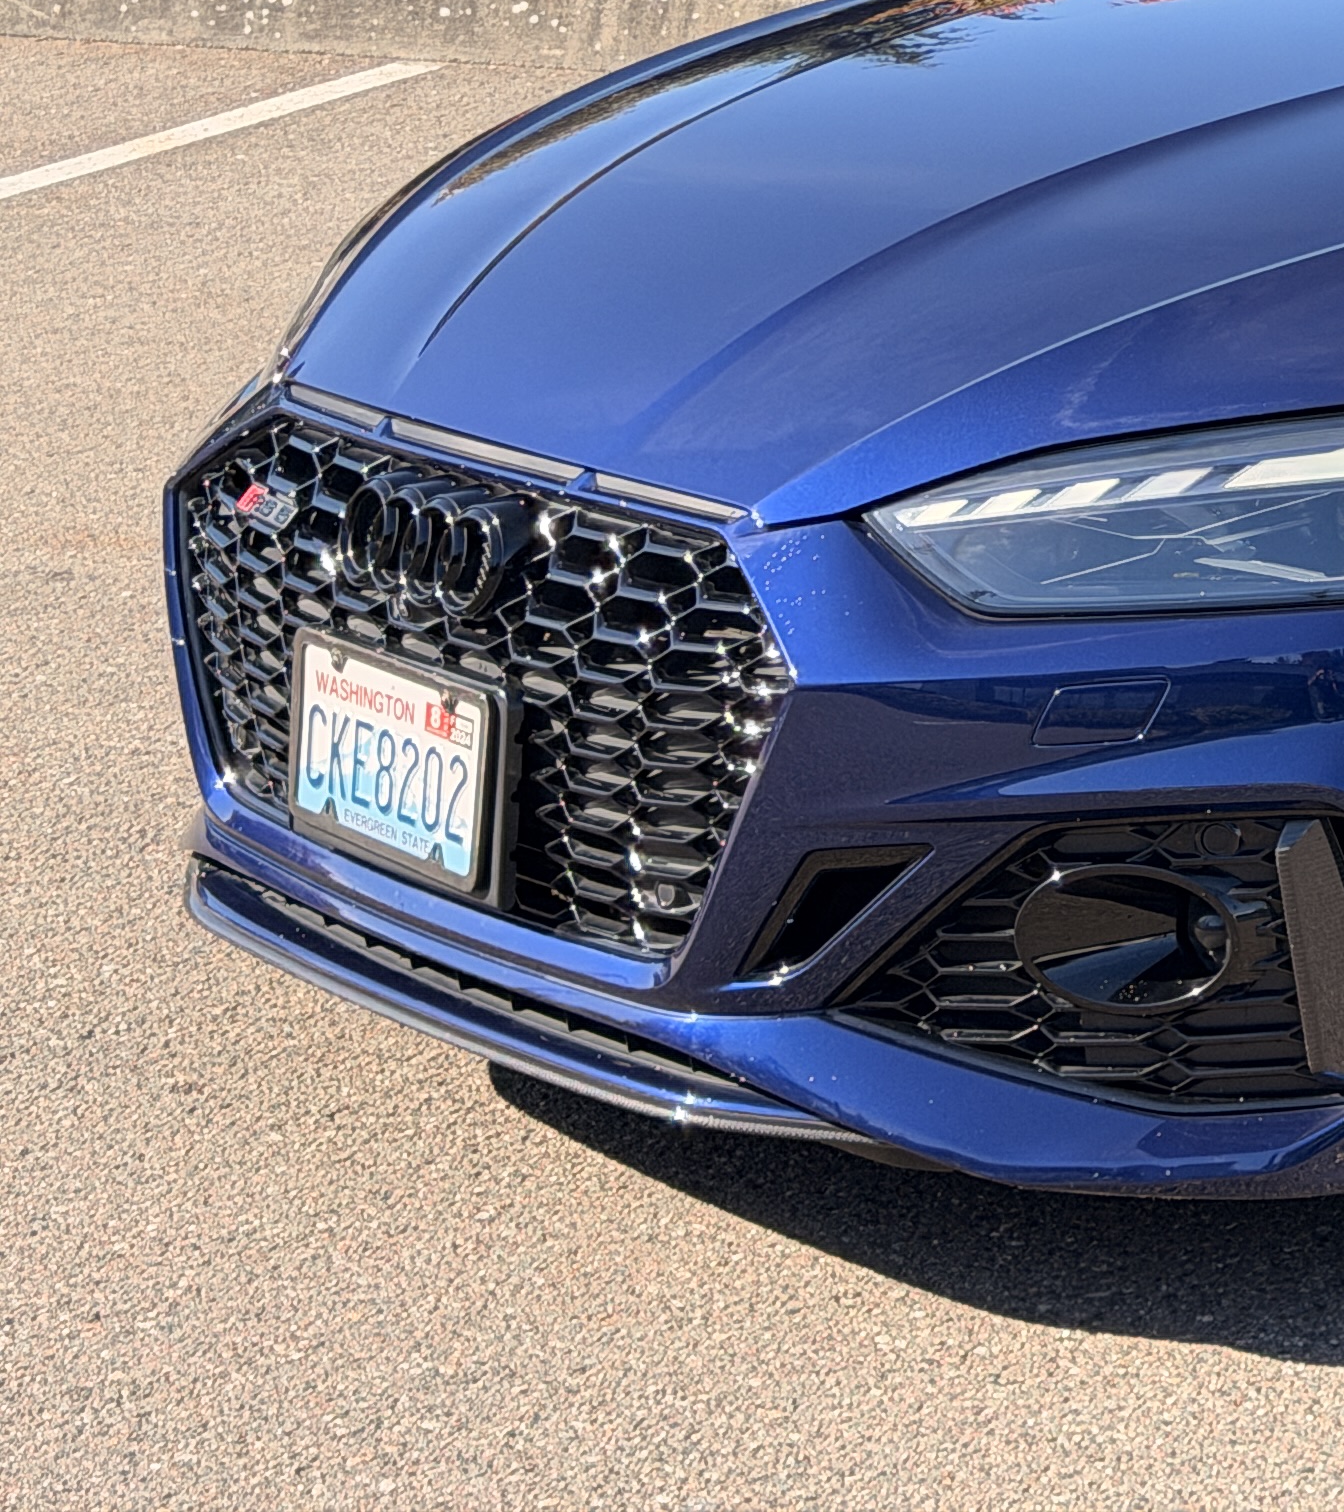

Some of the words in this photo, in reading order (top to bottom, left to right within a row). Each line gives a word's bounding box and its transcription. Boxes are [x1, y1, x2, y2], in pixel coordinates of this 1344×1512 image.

[315, 670, 416, 725] WASHINGTON
[306, 703, 468, 845] CKE8202
[343, 808, 398, 841] EVERGREEN
[401, 832, 431, 856] STATE
